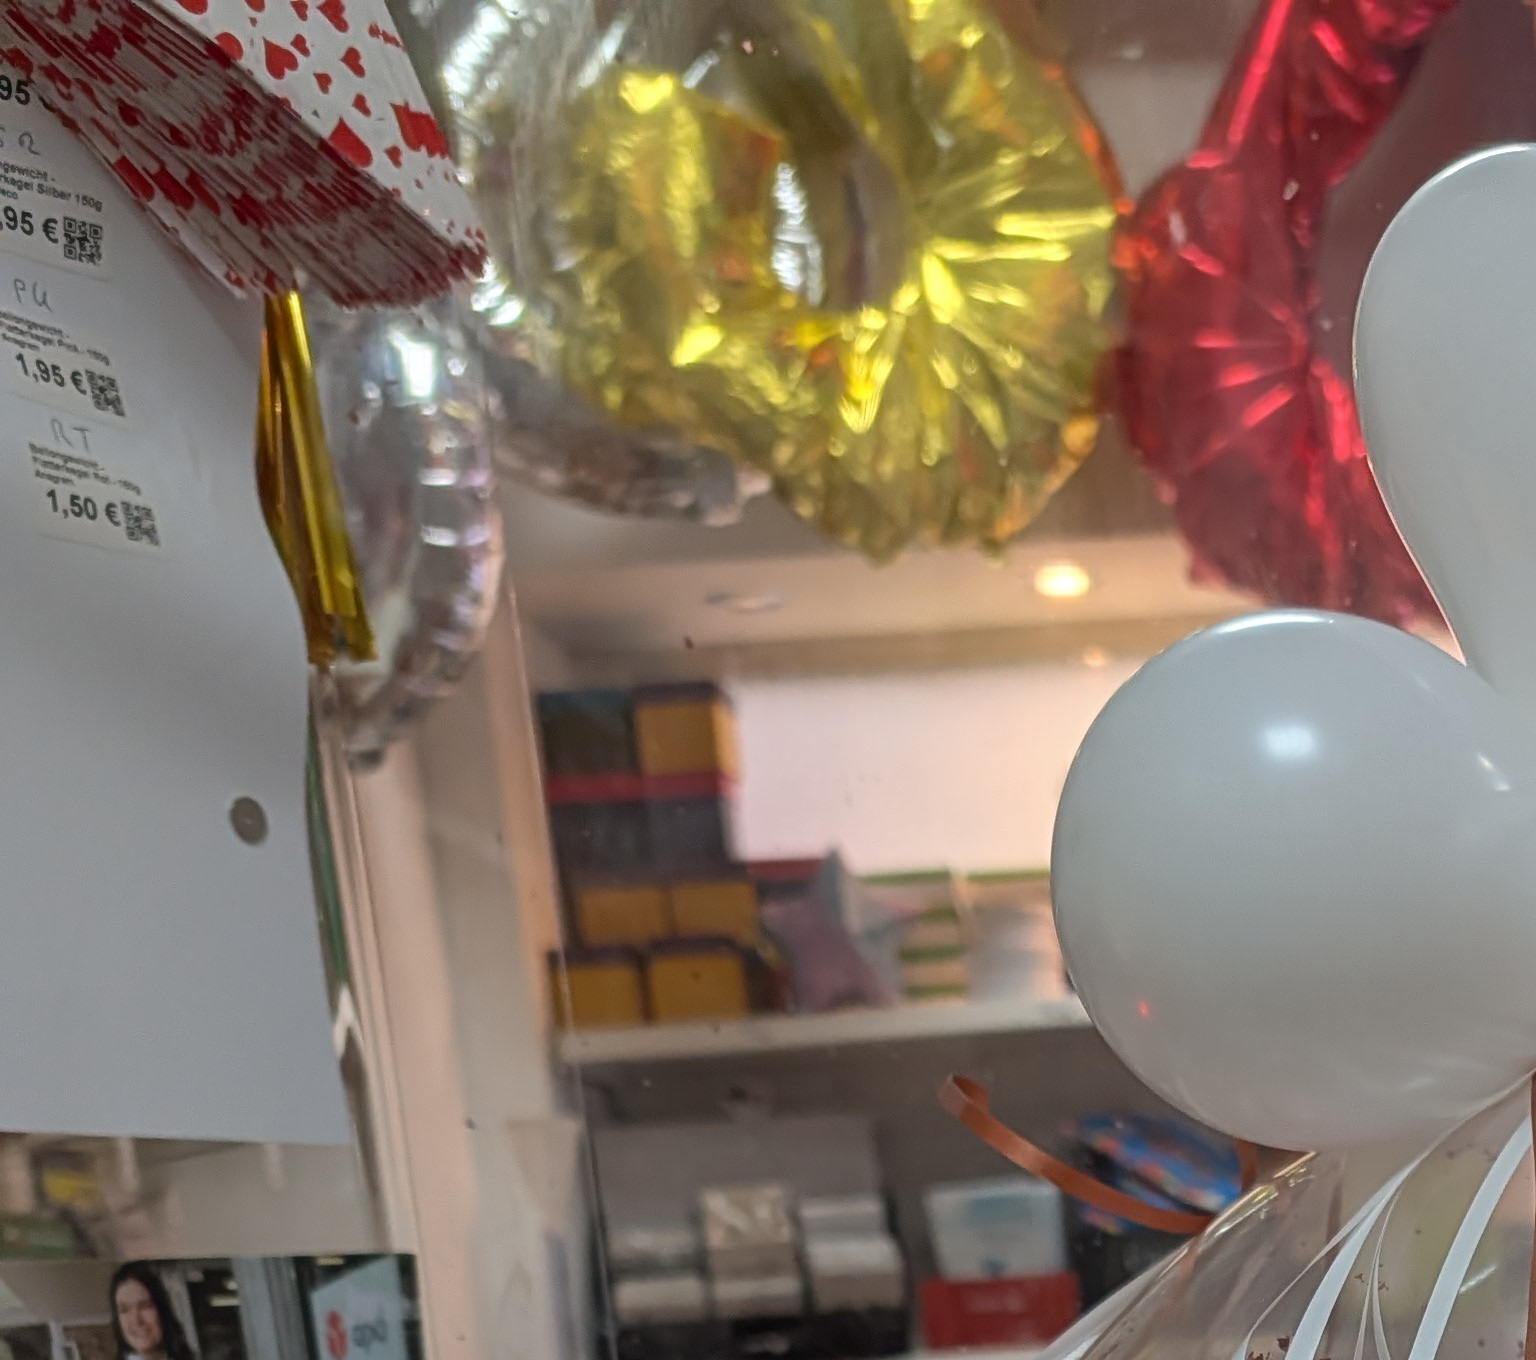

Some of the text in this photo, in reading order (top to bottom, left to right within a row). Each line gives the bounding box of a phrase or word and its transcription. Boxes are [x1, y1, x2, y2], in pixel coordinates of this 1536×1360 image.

[42, 217, 59, 244] €
[16, 352, 88, 396] 1,95 €
[46, 489, 121, 528] 1,50 €
